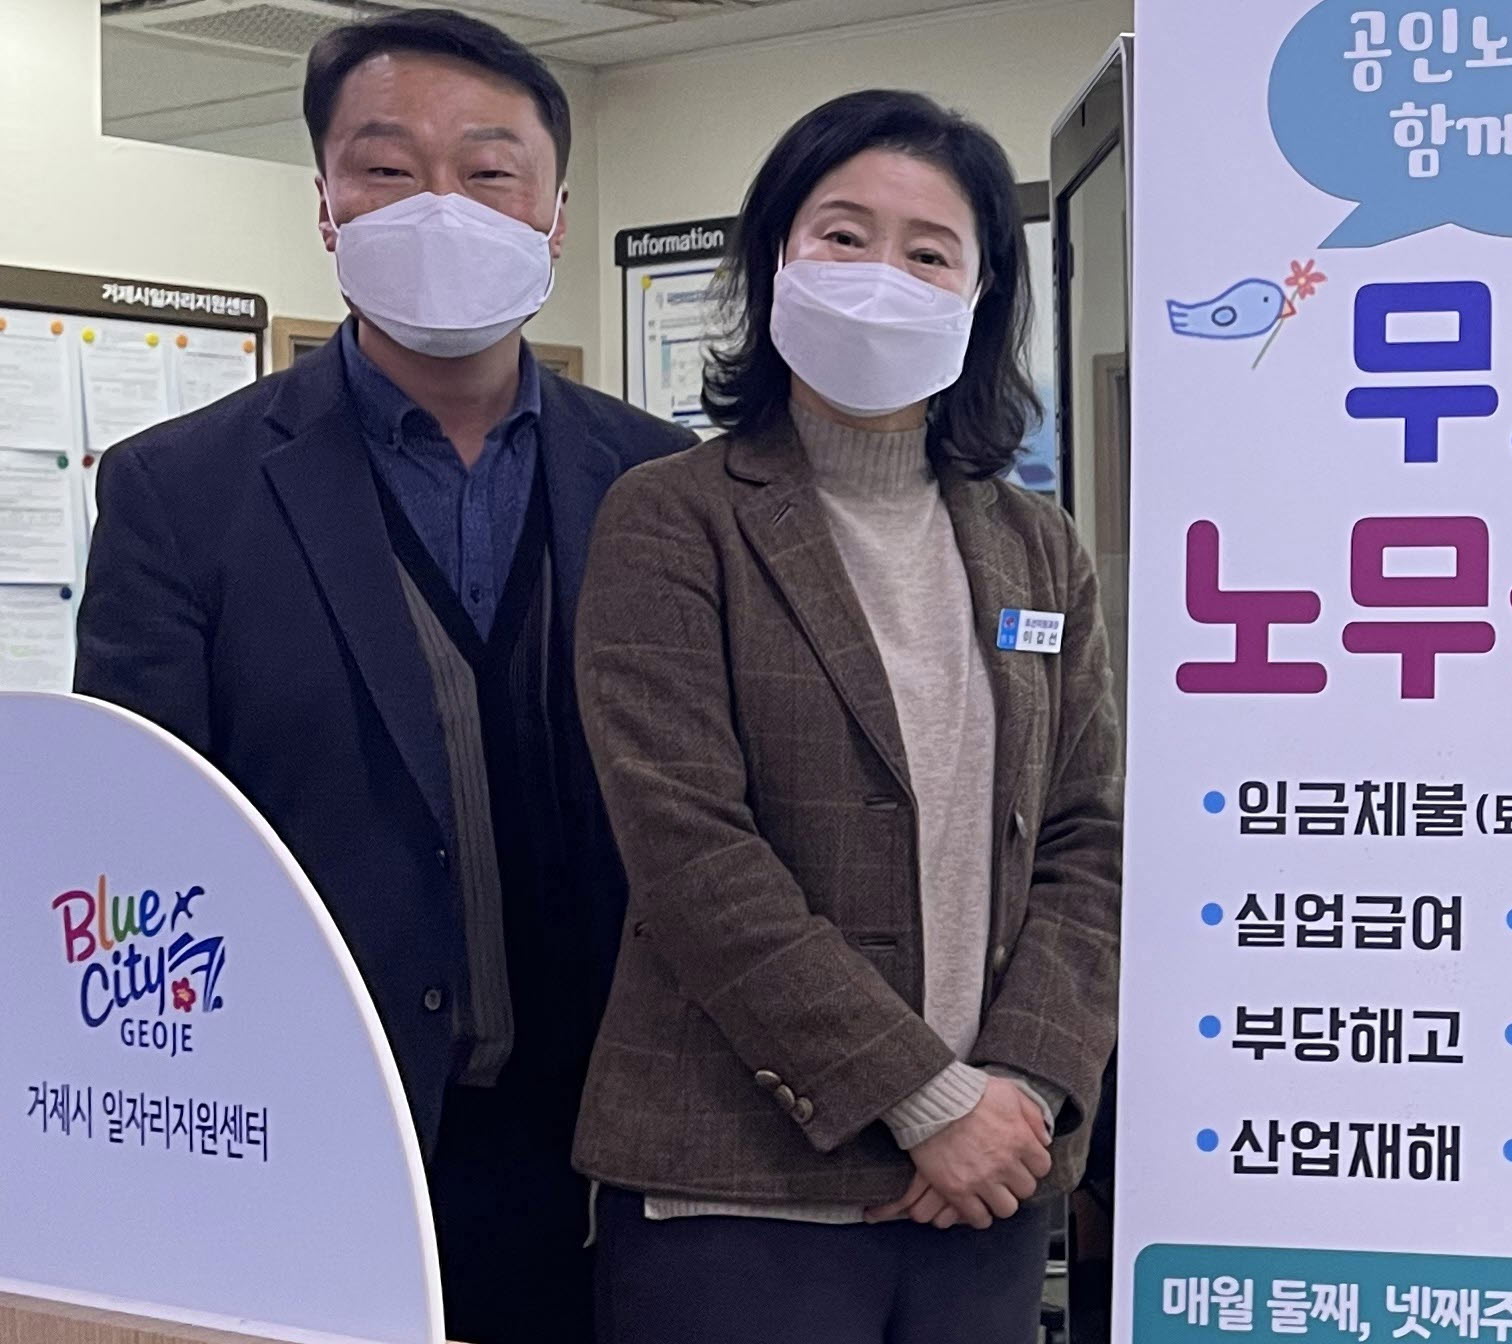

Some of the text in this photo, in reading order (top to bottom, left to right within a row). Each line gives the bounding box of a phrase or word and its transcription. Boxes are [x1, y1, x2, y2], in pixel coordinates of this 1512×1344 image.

[627, 227, 724, 257] Information
[52, 874, 166, 964] Blue
[1235, 894, 1462, 952] 실업급여
[81, 943, 165, 1028] City
[120, 1017, 193, 1058] GEOJE
[1232, 1006, 1464, 1064] 부당해고
[28, 1081, 268, 1162] 거제시 일자리지원센터
[1231, 1120, 1461, 1182] 산업재해
[1163, 1276, 1254, 1331] 매월
[1267, 1280, 1371, 1342] 둘째,
